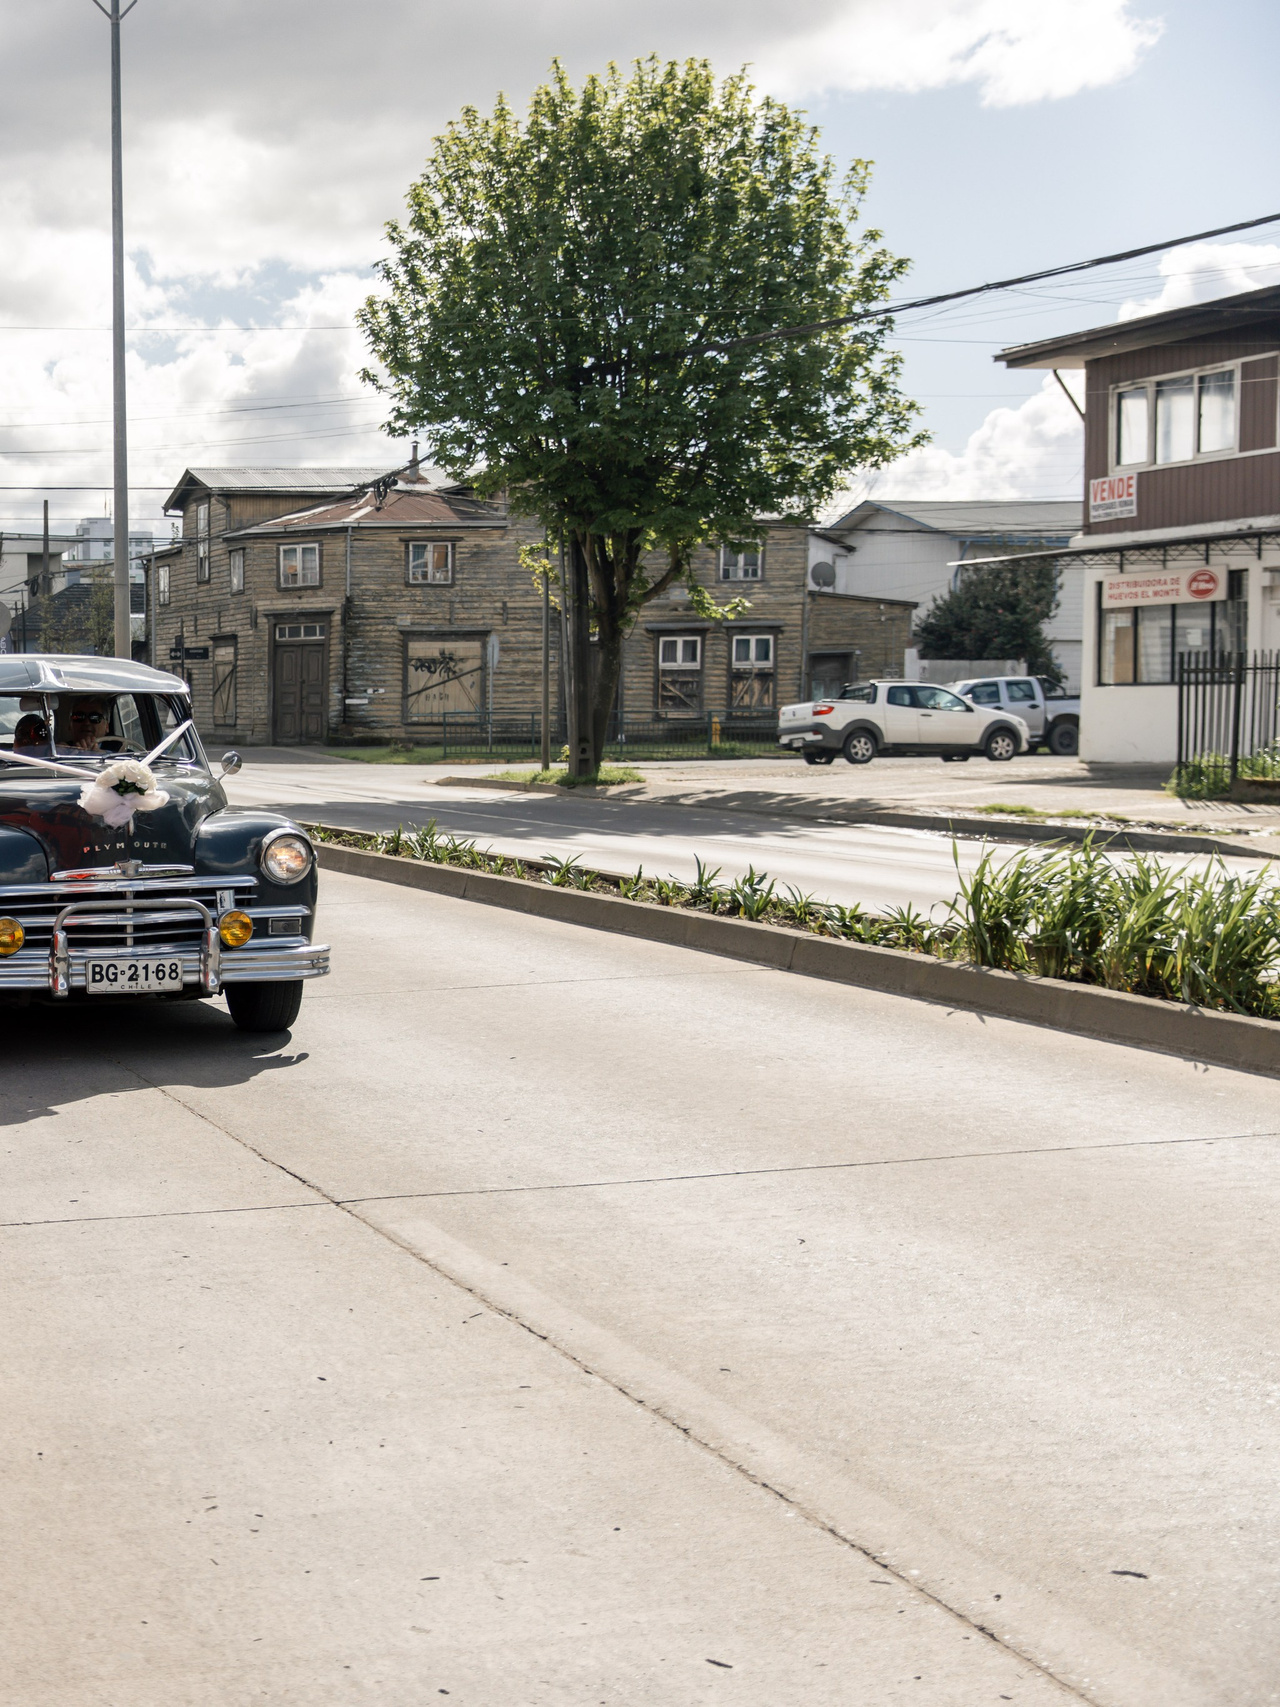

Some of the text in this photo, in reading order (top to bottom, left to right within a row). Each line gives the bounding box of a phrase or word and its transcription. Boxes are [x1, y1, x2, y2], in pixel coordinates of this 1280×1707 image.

[1092, 475, 1134, 503] VENDE
[1108, 579, 1168, 590] DISTRIBUIDORA
[1170, 577, 1180, 586] DE
[1108, 588, 1180, 600] HUEVOS EL MONTE
[83, 840, 167, 854] PLYMOUTH
